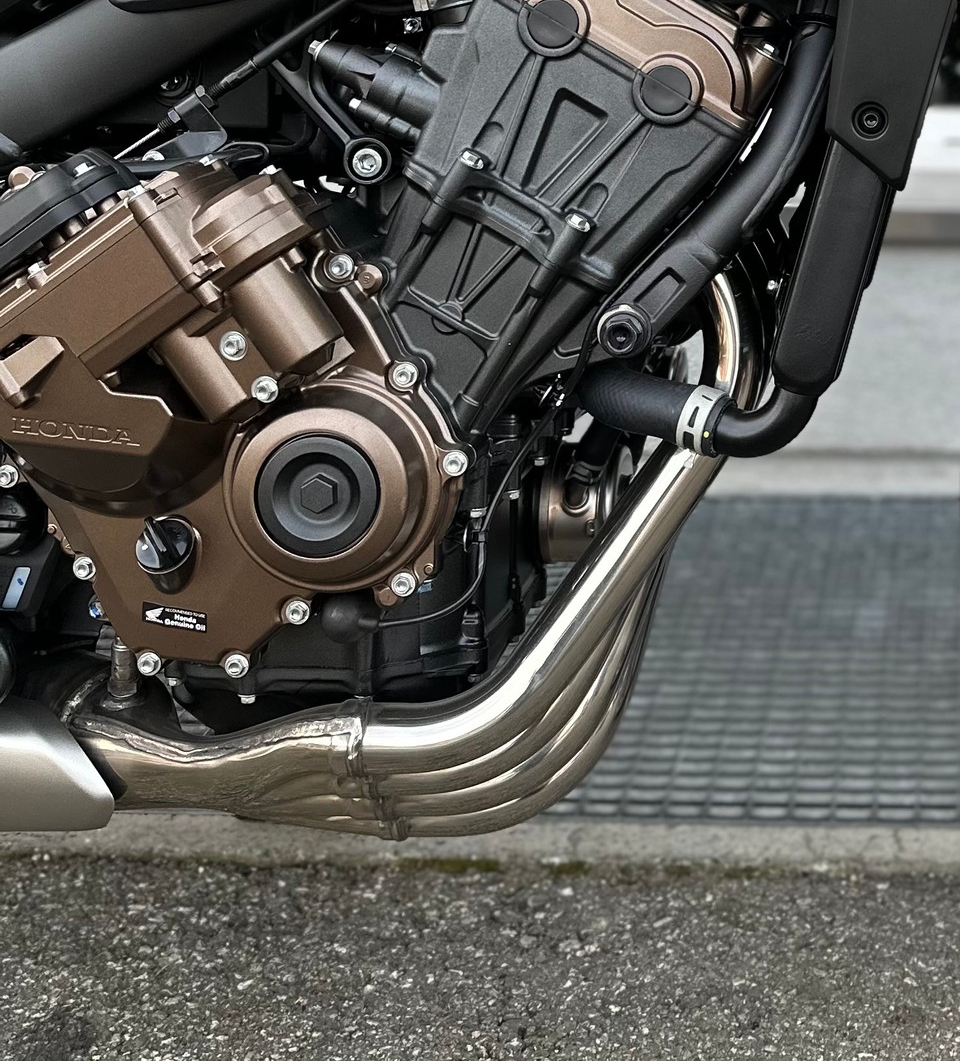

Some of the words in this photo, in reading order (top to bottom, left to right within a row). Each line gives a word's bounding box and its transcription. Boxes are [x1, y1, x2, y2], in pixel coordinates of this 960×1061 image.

[12, 416, 140, 446] HONDA
[164, 618, 194, 629] Genuine
[195, 623, 206, 631] Oil
[174, 614, 197, 624] Honda
